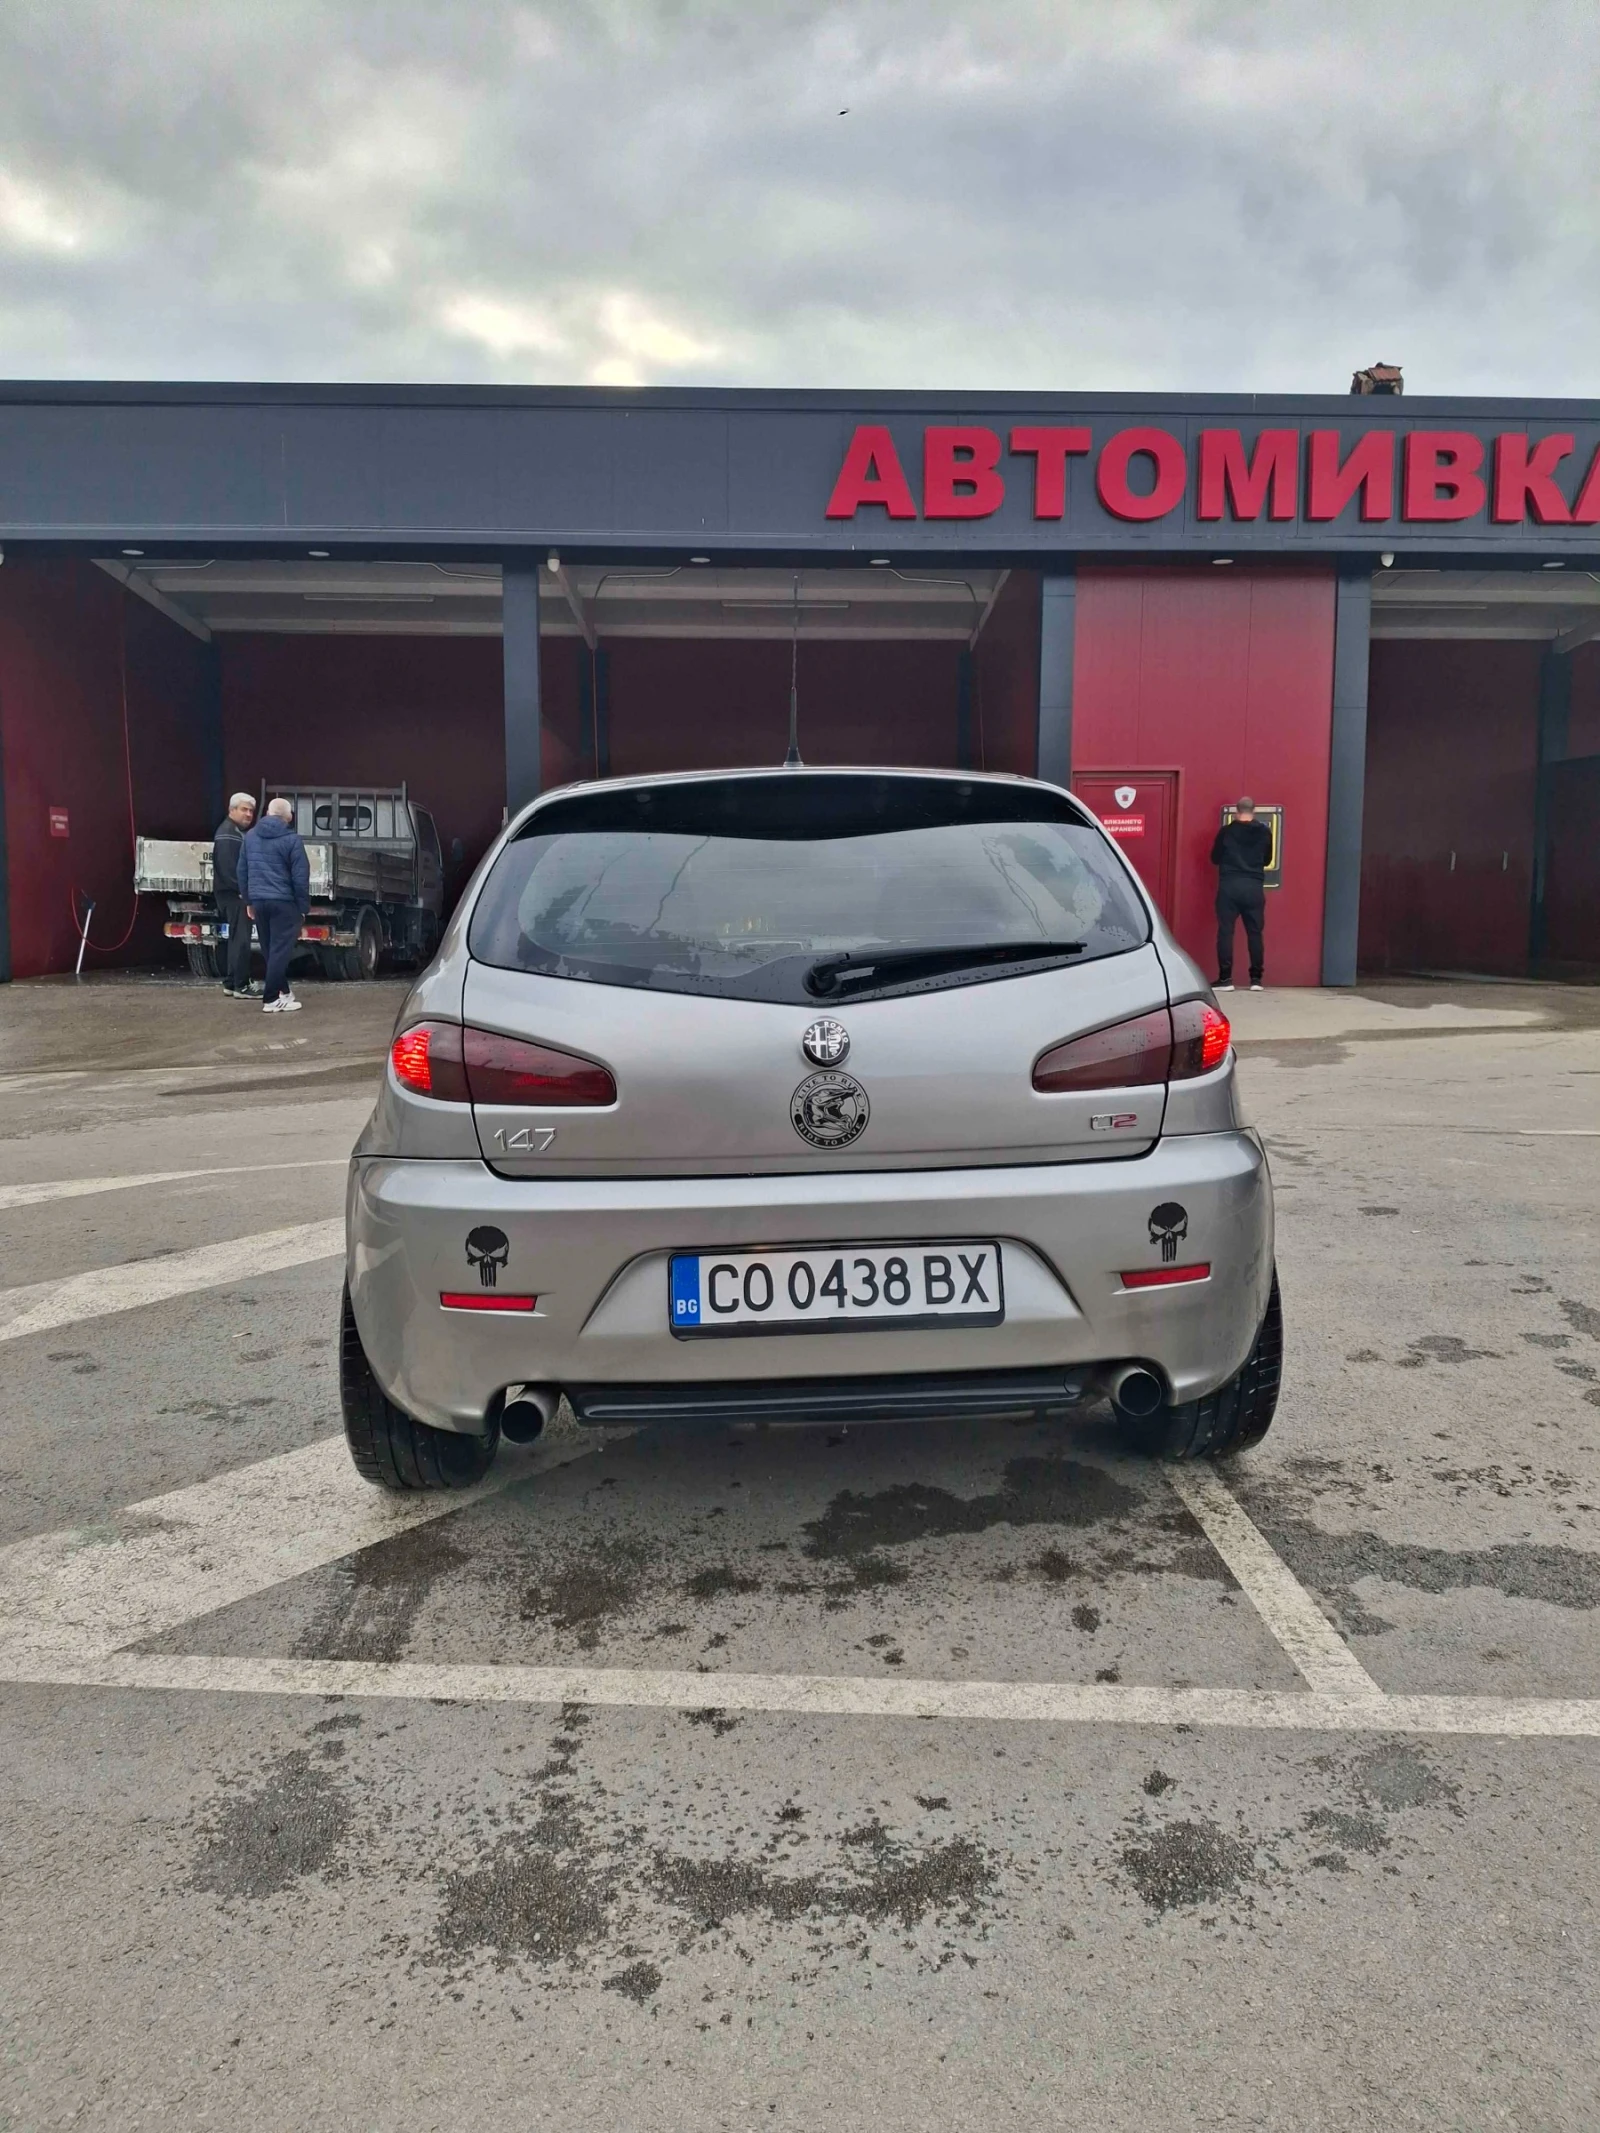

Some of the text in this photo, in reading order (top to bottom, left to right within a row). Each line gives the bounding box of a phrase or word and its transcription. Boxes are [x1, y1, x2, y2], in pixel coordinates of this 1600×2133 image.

[804, 1021, 849, 1045] ALFA ROMEO
[798, 1079, 818, 1099] LIVE
[841, 1078, 862, 1099] RIDE
[494, 1127, 556, 1151] 147
[799, 1123, 819, 1143] RIDE
[841, 1123, 862, 1142] LIVE
[708, 1253, 990, 1314] CO 0438 BX
[676, 1299, 698, 1315] BG
